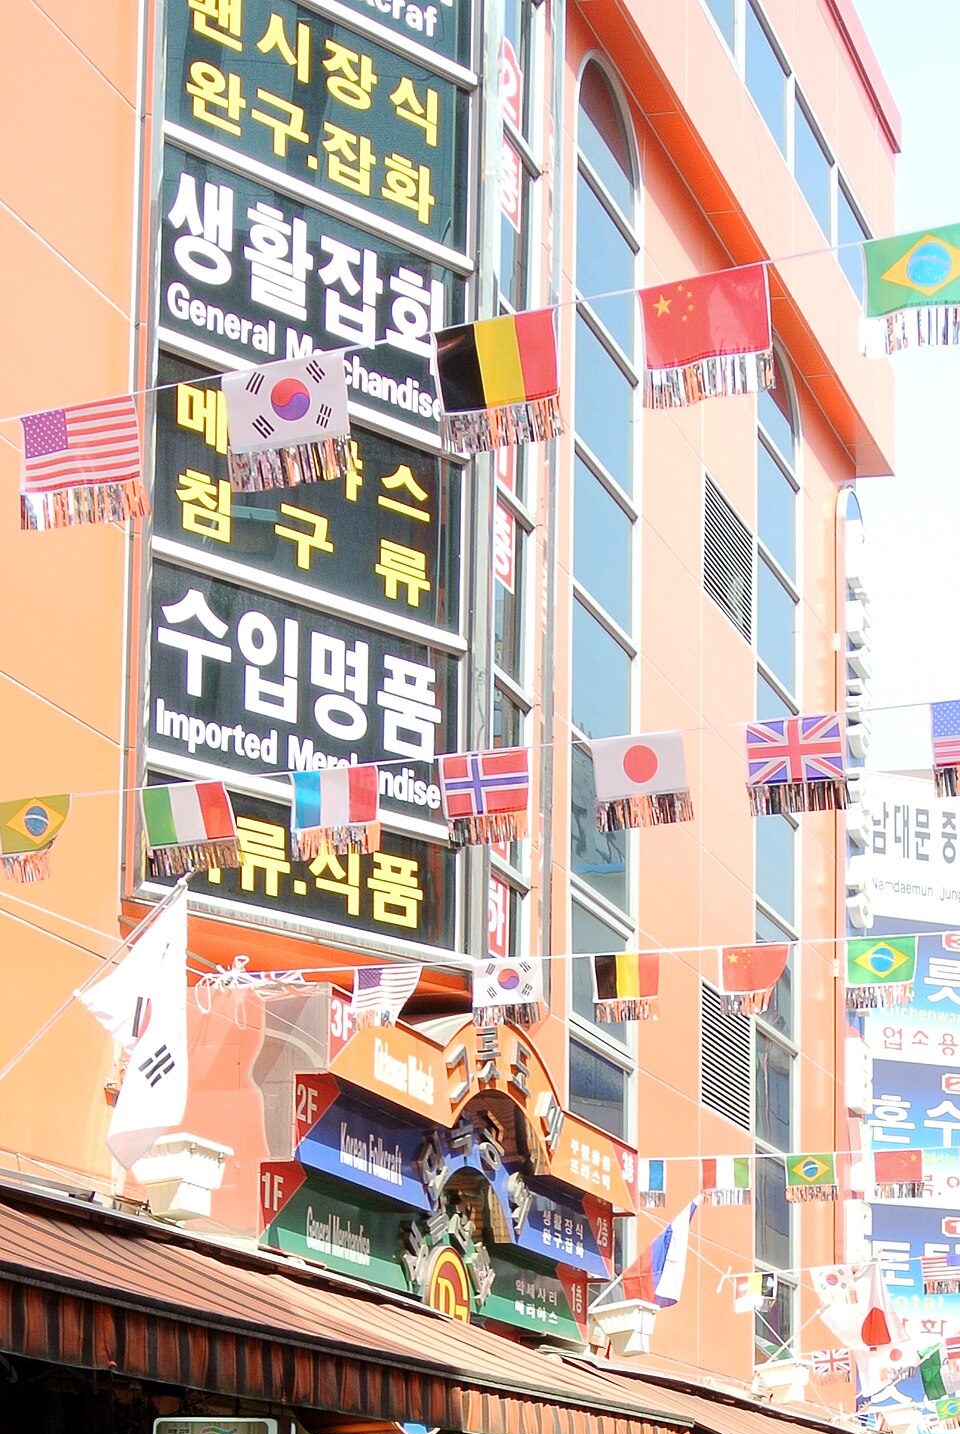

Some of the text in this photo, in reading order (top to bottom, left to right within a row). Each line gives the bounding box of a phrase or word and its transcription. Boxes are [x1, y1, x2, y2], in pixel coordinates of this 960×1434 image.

[186, 61, 435, 225] 완구.잡화
[167, 172, 446, 376] 생활잡화
[166, 282, 442, 423] General Mchandise
[176, 383, 430, 522] 메스
[175, 467, 431, 607] 침구류
[157, 588, 442, 764] 수입명품
[156, 698, 442, 810] Imported Merndise
[196, 816, 424, 929] 류.식품
[871, 801, 932, 861] 남대문
[872, 877, 934, 898] Namdaemun
[331, 1000, 353, 1040] 3F
[296, 1084, 319, 1124] 2F
[340, 1122, 403, 1186] Korean Folkcraft
[262, 1171, 284, 1212] 1F
[306, 1206, 370, 1266] General Merchandise
